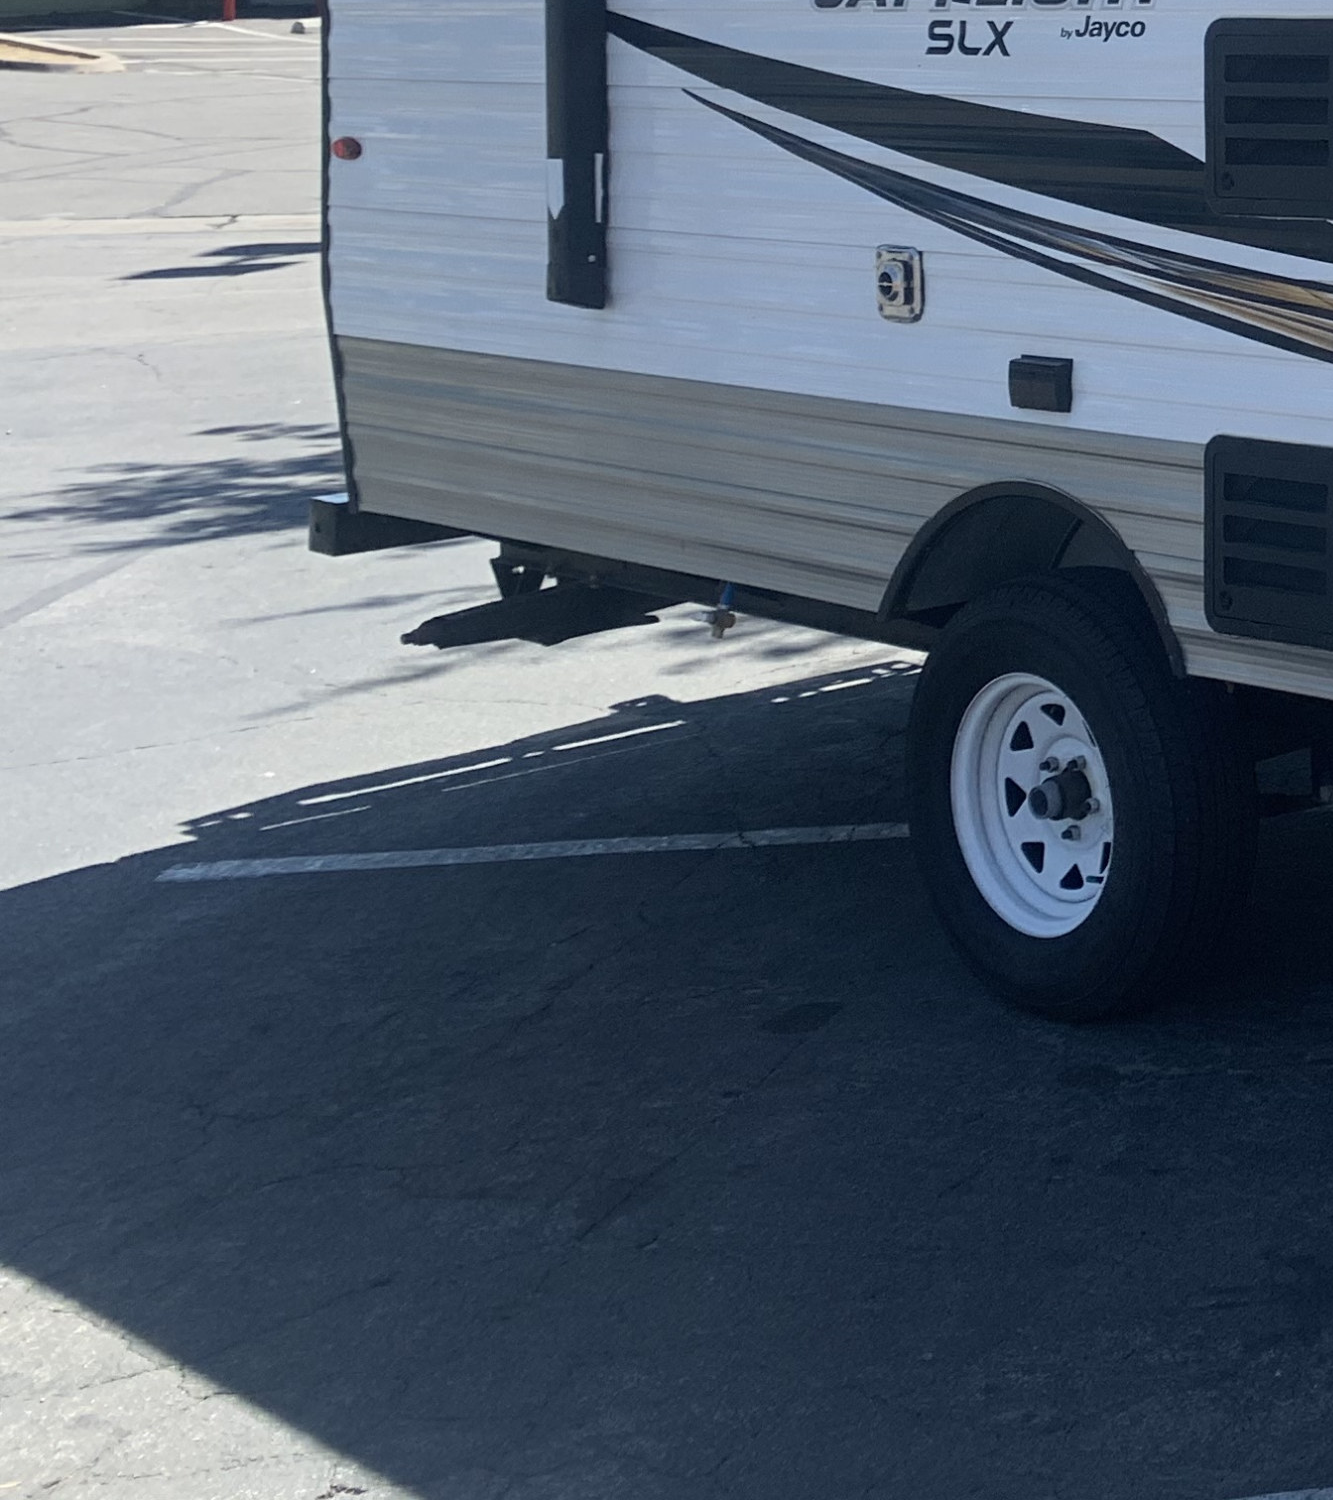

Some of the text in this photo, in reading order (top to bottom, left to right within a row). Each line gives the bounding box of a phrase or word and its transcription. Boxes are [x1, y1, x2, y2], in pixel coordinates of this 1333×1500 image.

[925, 20, 1014, 56] SLX
[1060, 15, 1146, 43] by Jayco
